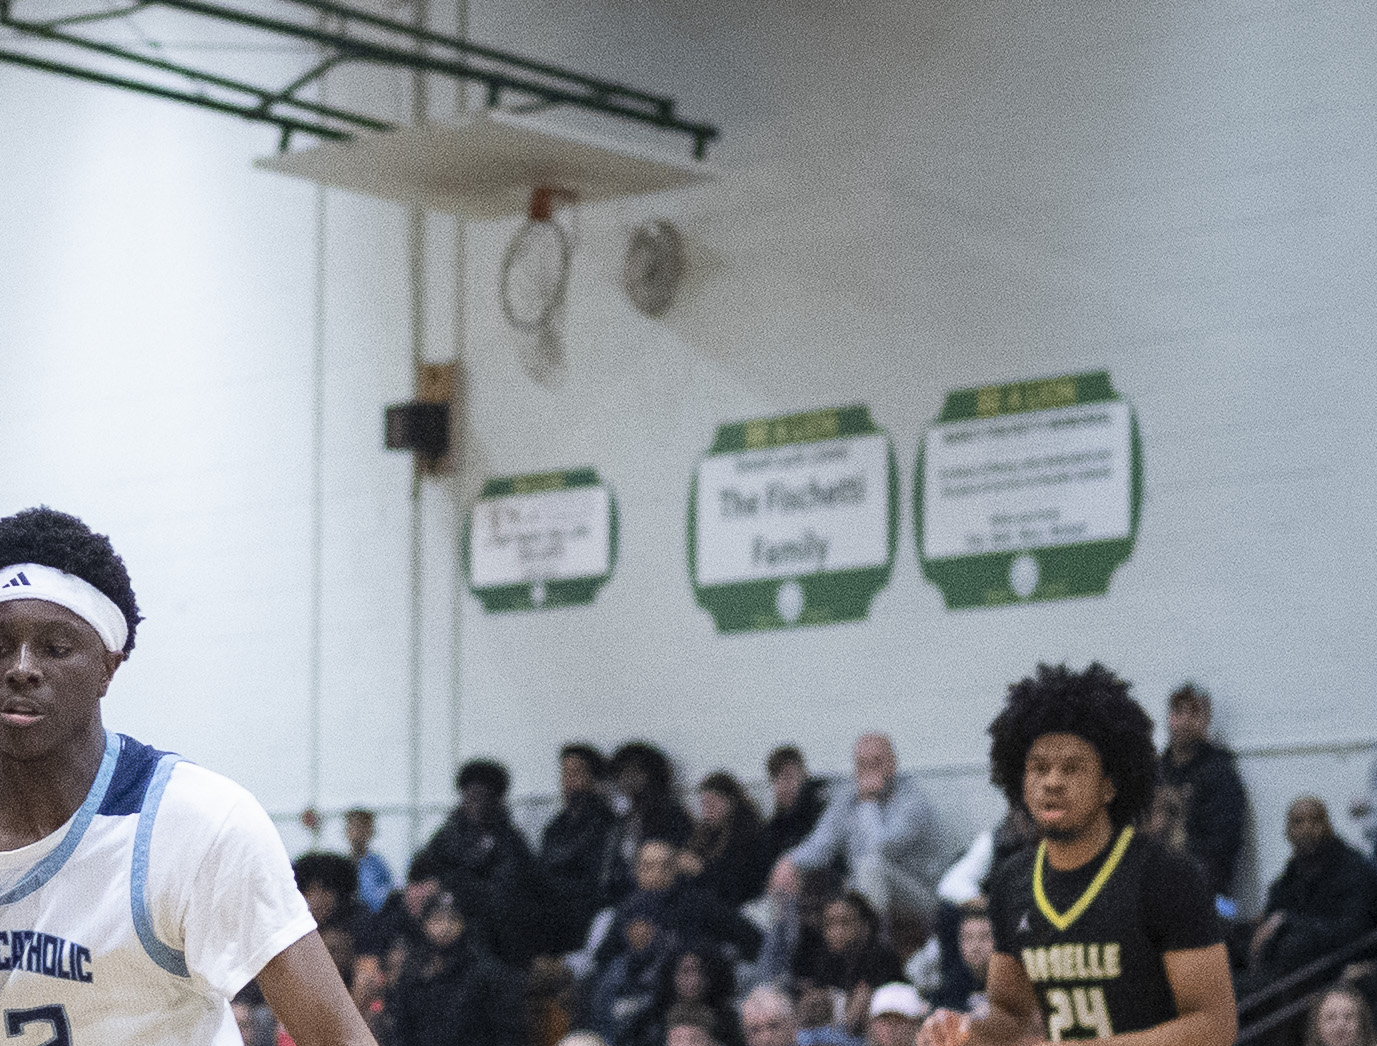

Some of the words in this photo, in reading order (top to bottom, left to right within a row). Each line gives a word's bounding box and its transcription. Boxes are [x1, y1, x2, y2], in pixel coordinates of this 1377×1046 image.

[721, 486, 758, 520] The
[752, 528, 830, 568] Family
[1047, 986, 1112, 1042] 24
